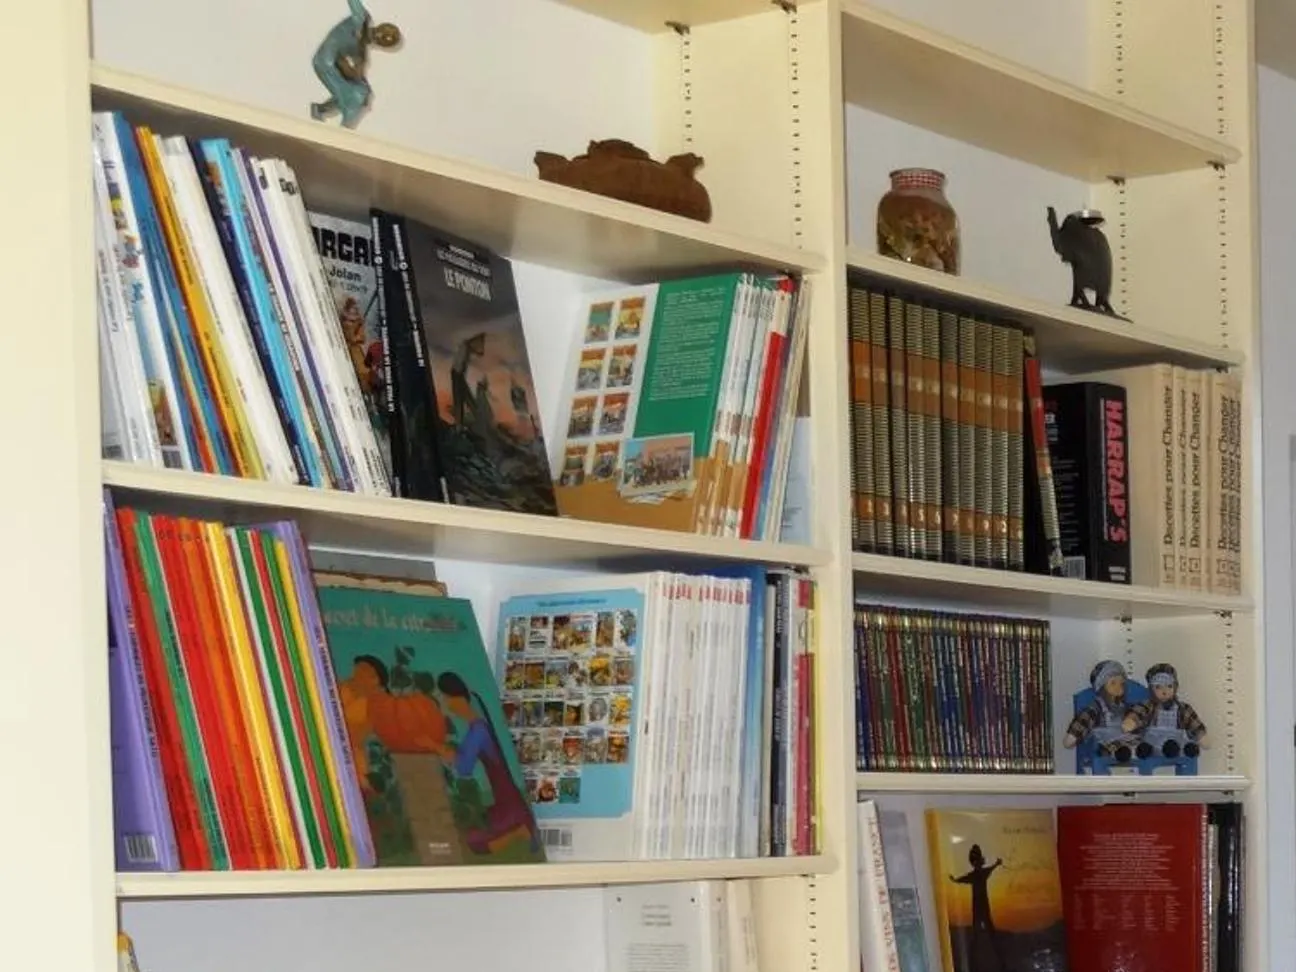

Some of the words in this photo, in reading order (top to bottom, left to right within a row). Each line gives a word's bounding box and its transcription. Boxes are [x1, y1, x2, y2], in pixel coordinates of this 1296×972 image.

[312, 226, 375, 267] RGA
[330, 265, 362, 282] Jolan
[1105, 399, 1128, 543] HARRAP'S
